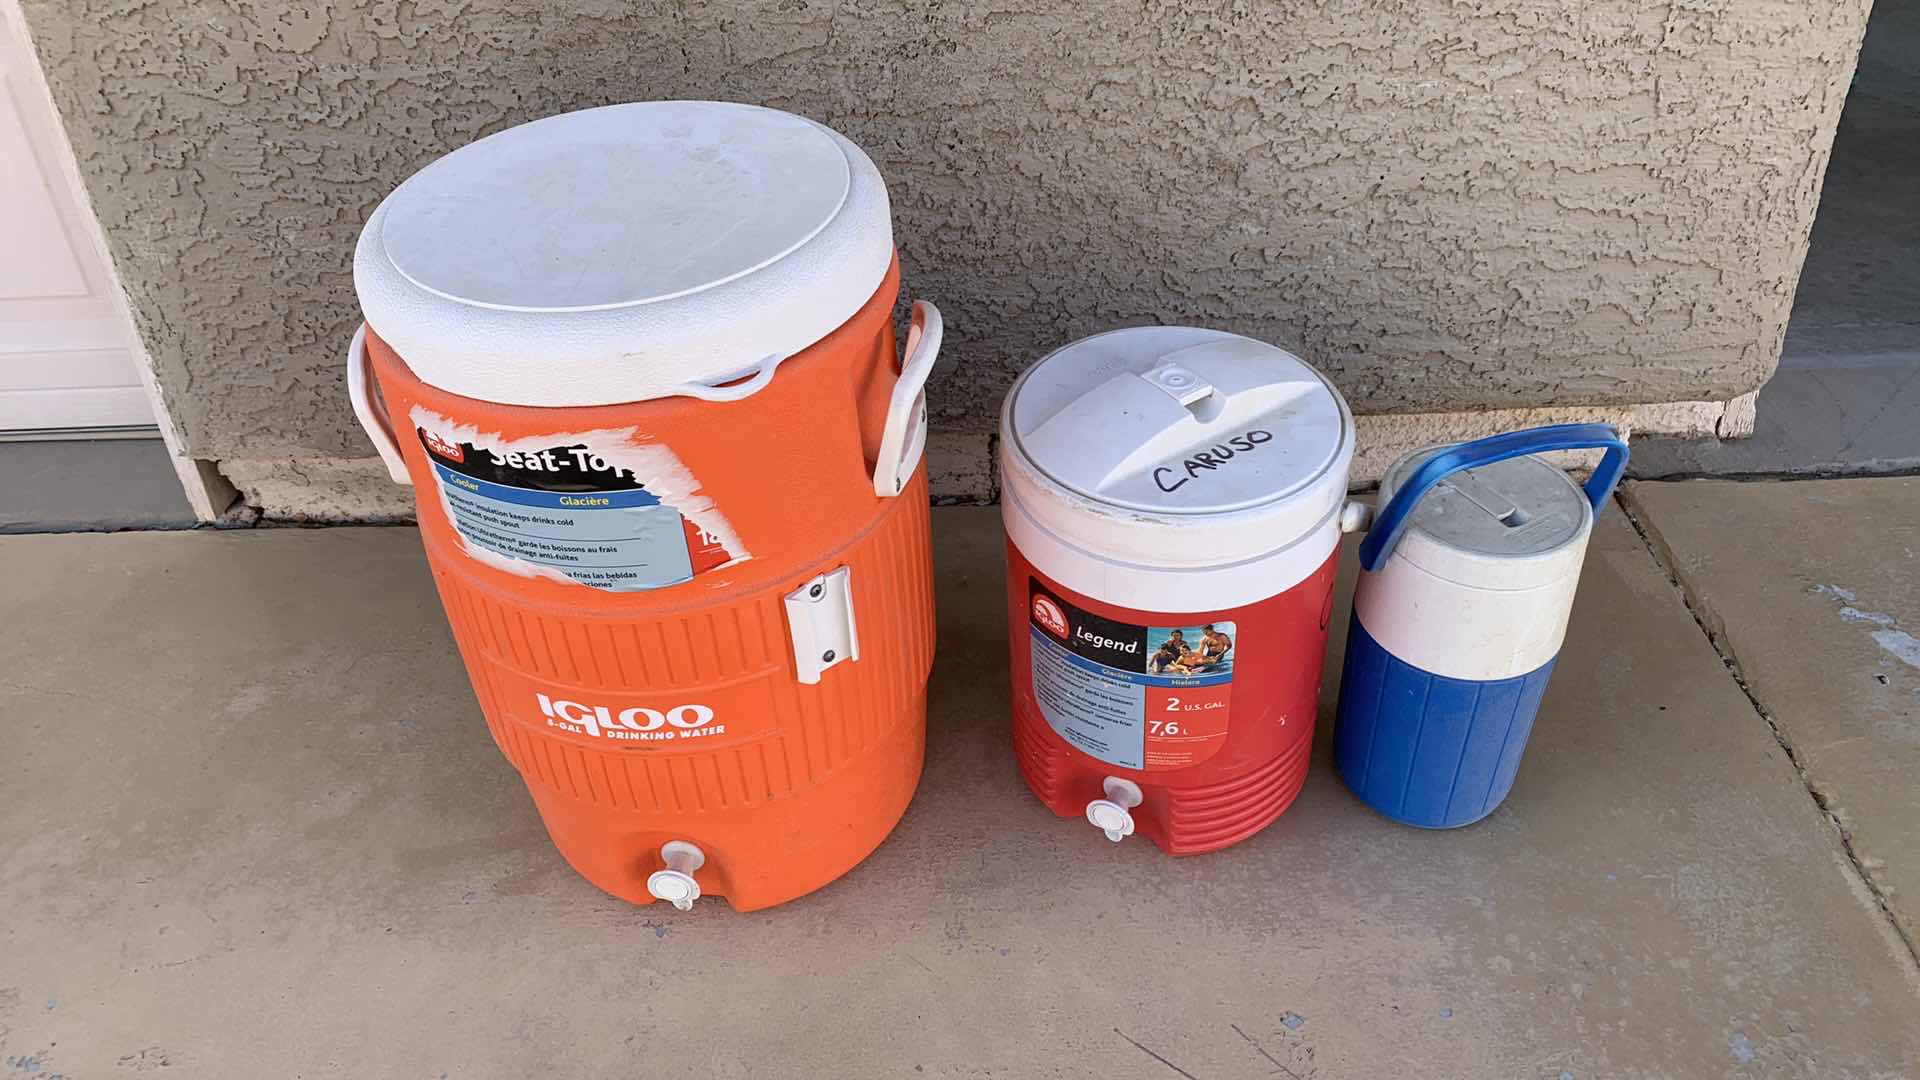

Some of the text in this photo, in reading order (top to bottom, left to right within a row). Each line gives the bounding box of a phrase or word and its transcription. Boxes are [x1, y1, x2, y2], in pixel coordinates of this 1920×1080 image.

[1153, 430, 1273, 493] CARUSO
[559, 496, 609, 507] Glacière
[509, 512, 530, 523] keeps
[531, 515, 555, 526] drinks
[556, 518, 575, 527] cold
[540, 543, 551, 551] les
[552, 544, 586, 554] boissons
[599, 546, 618, 554] frais
[606, 571, 638, 580] bebidas
[1166, 697, 1180, 712] 2
[536, 693, 714, 737] IGLOO
[607, 730, 675, 741] DRINKING
[679, 725, 725, 739] WATER
[1150, 721, 1190, 737] 7,6 L
